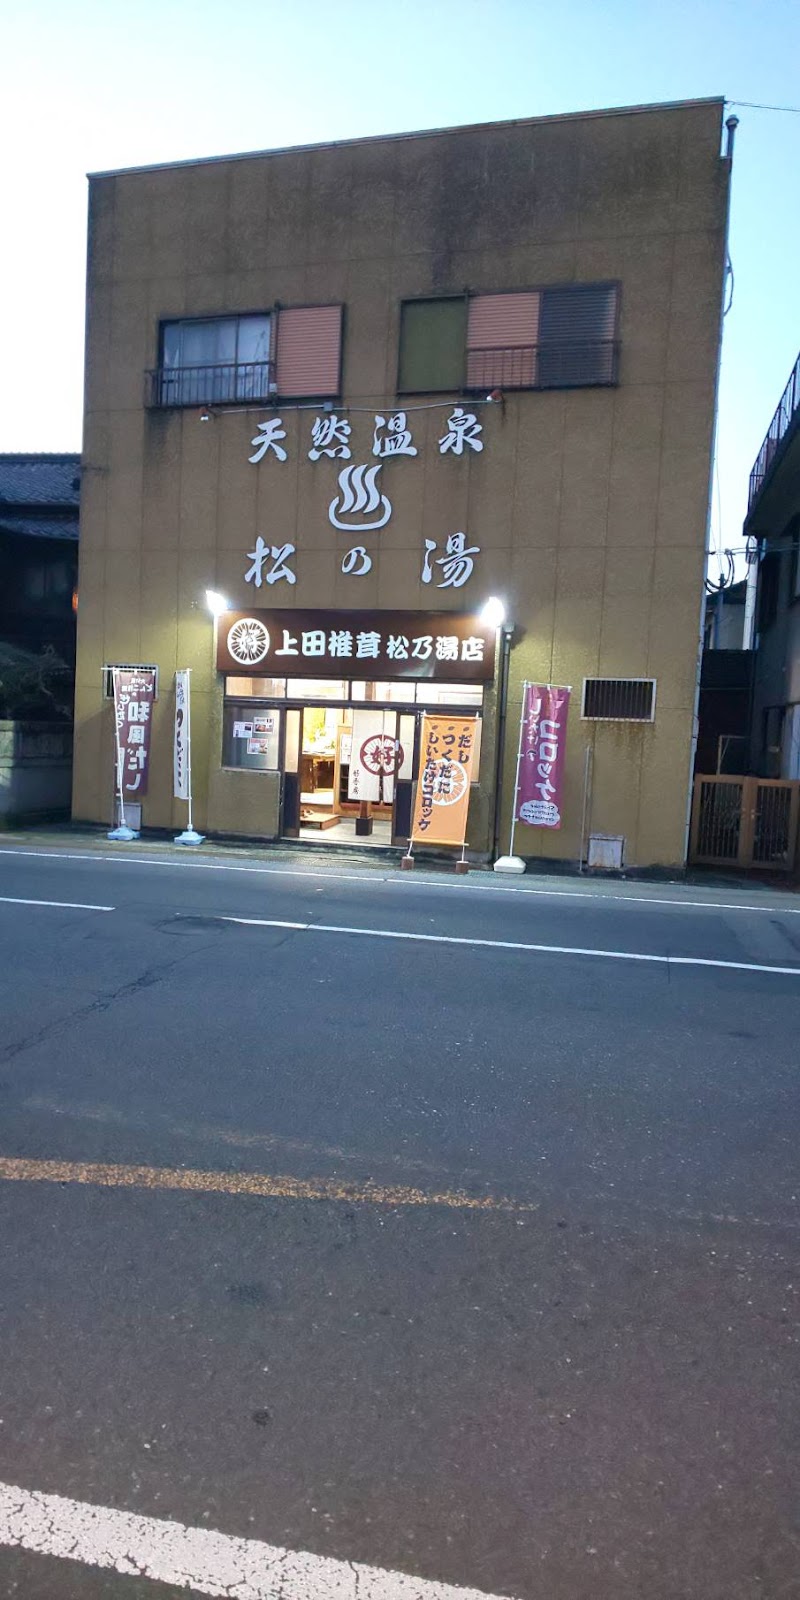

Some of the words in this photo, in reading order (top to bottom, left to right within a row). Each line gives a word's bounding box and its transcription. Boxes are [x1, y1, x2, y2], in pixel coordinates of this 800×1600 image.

[247, 407, 484, 464] 天然温泉
[243, 532, 482, 589] 松の湯
[370, 745, 396, 766] 好
[438, 734, 456, 794] つくだに
[457, 734, 472, 764] だし
[418, 731, 439, 831] しいたけコロッケ
